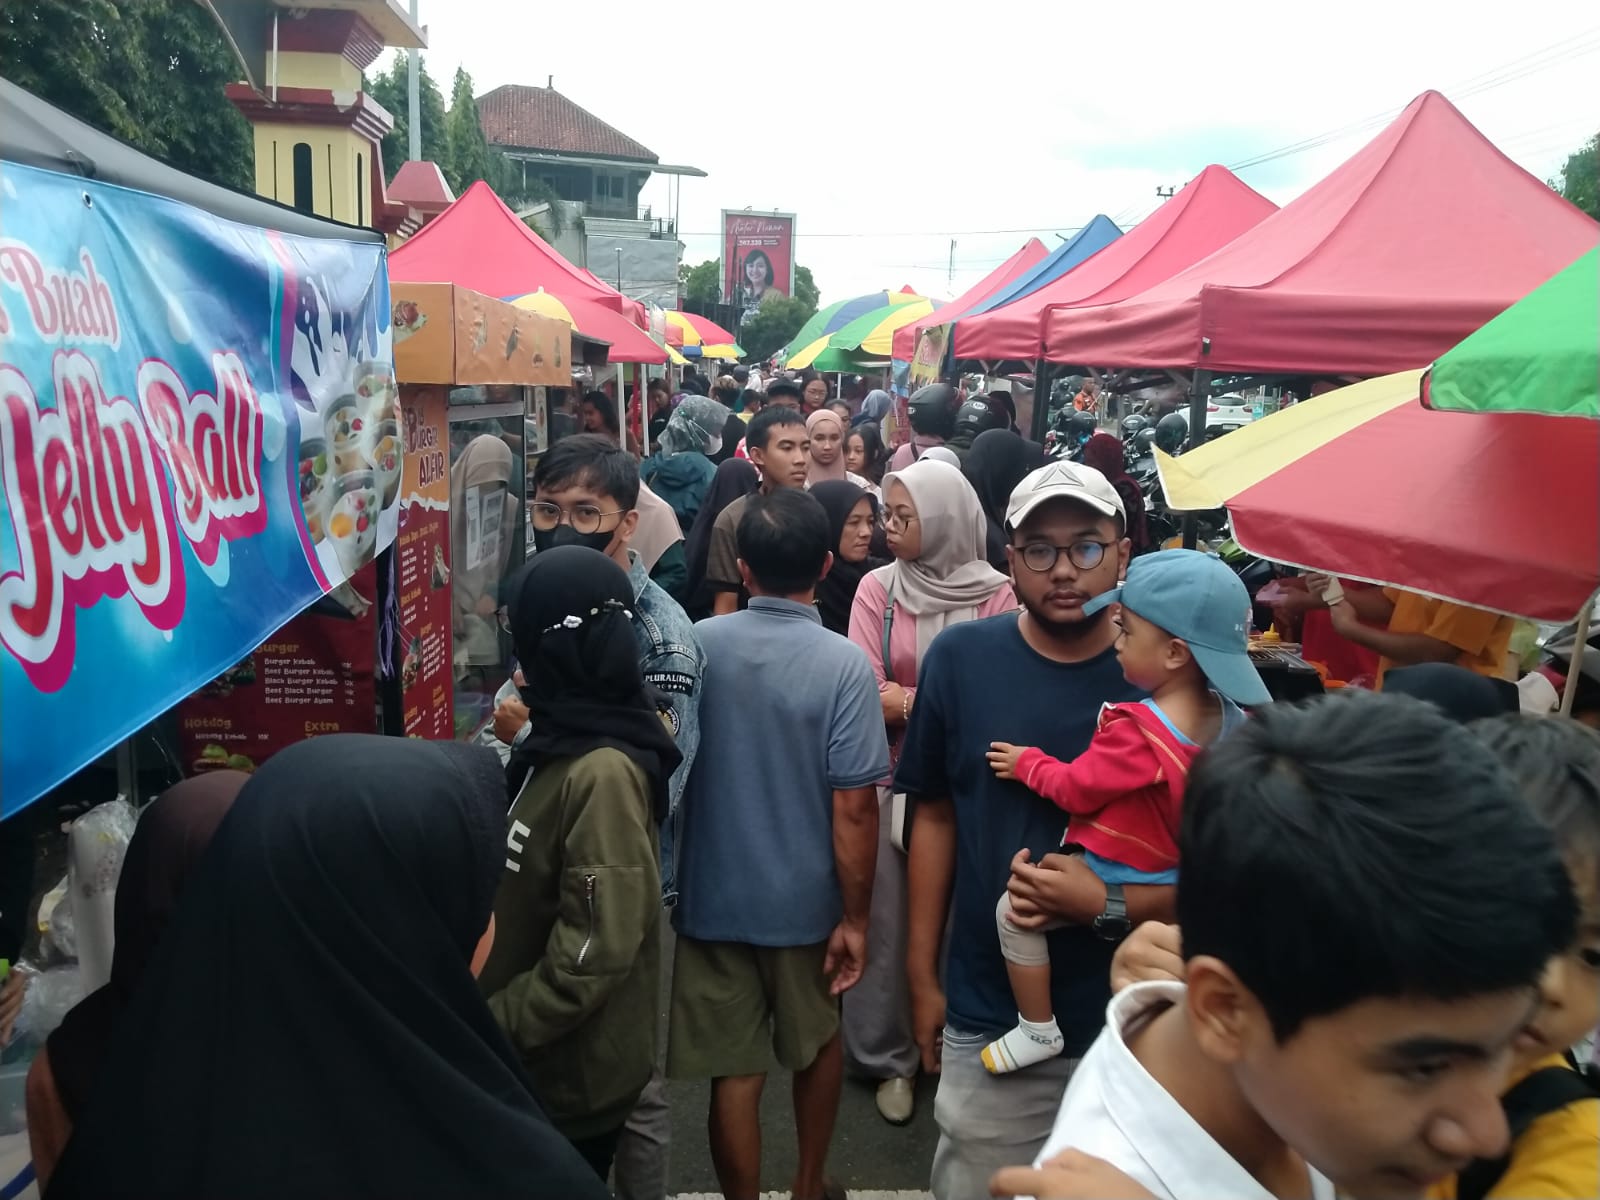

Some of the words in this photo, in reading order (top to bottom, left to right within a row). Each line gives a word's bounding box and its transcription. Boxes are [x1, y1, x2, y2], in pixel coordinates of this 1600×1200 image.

[0, 244, 119, 345] Buah
[0, 352, 168, 662] Jelly
[139, 356, 261, 541] Ball
[264, 658, 291, 666] Burger
[287, 677, 314, 685] Burger
[314, 697, 334, 705] Ayam
[184, 718, 232, 730] Hotdog
[304, 720, 340, 732] Extra
